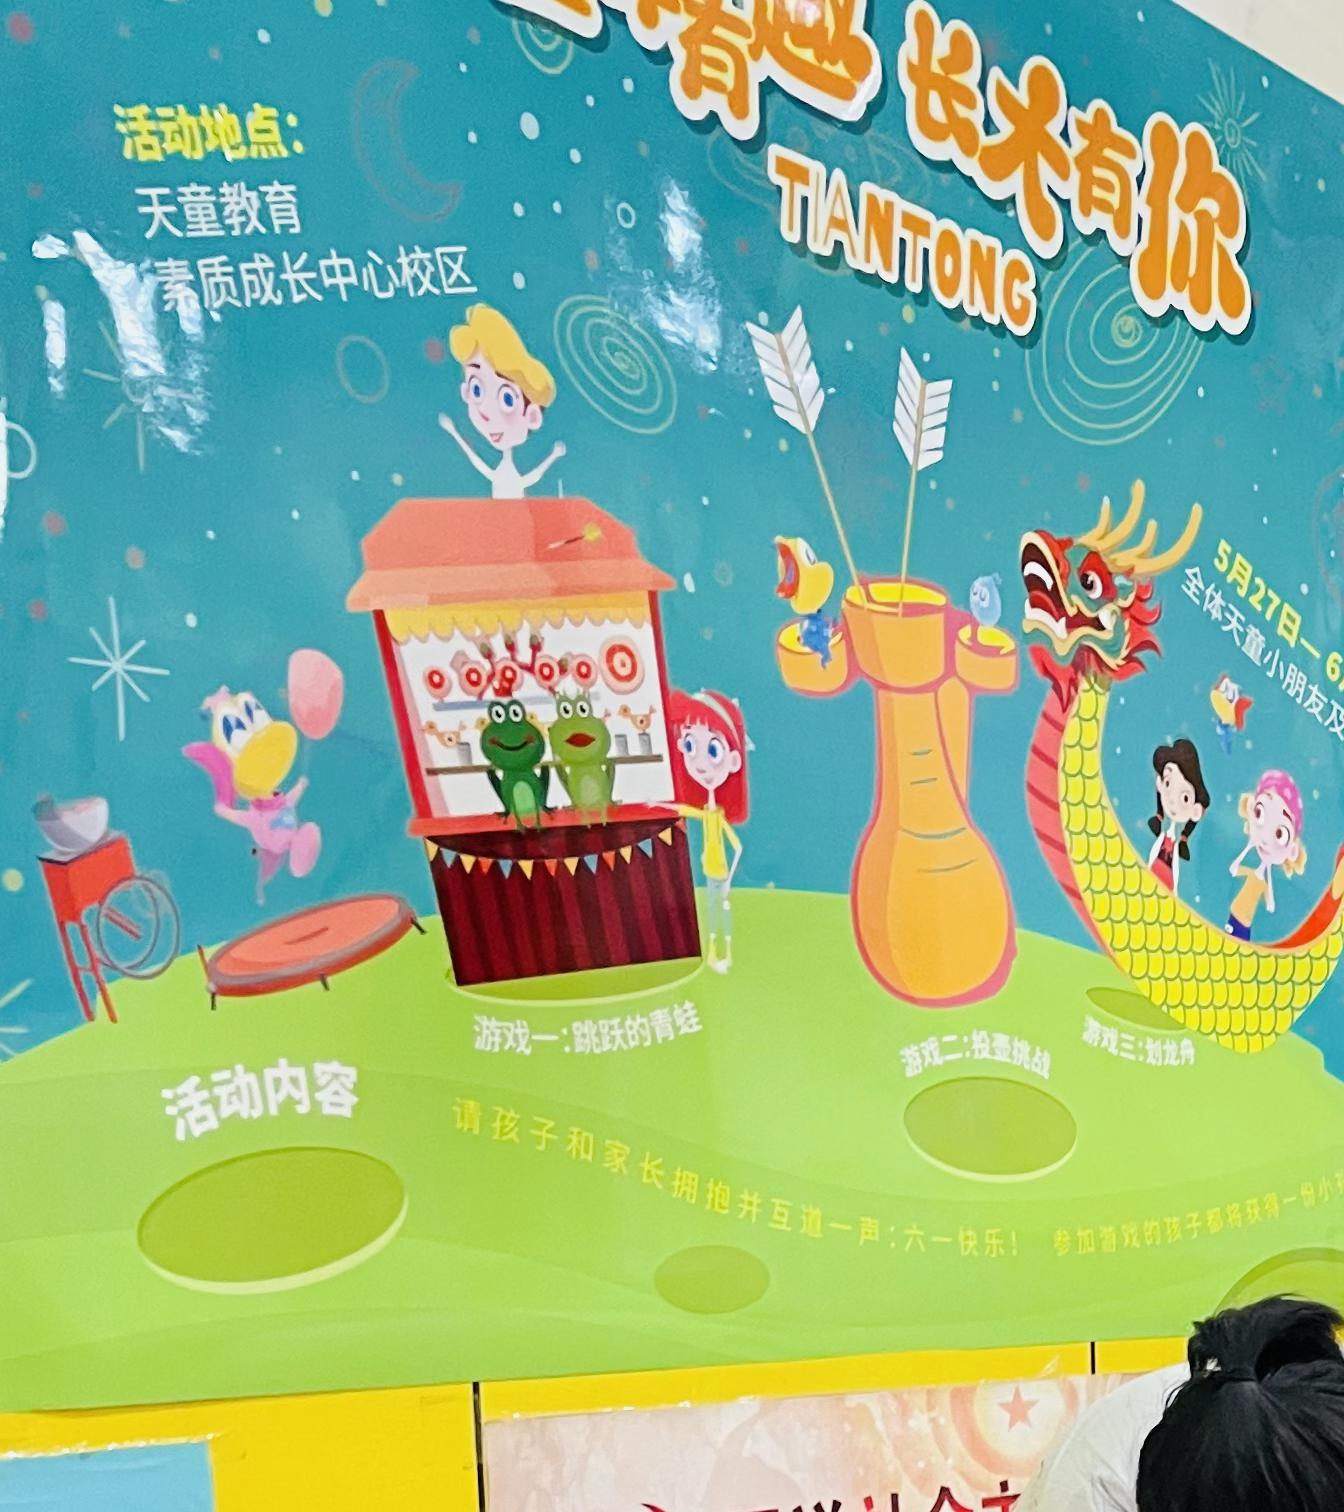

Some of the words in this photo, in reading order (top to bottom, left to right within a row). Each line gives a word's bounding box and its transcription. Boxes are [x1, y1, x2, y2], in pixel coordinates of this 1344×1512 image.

[113, 102, 304, 163] 活动地点：
[134, 181, 302, 240] 天童教育
[769, 150, 1033, 332] TIANTONG
[154, 245, 478, 314] 素质成长中心校区
[161, 1056, 360, 1142] 活动内容
